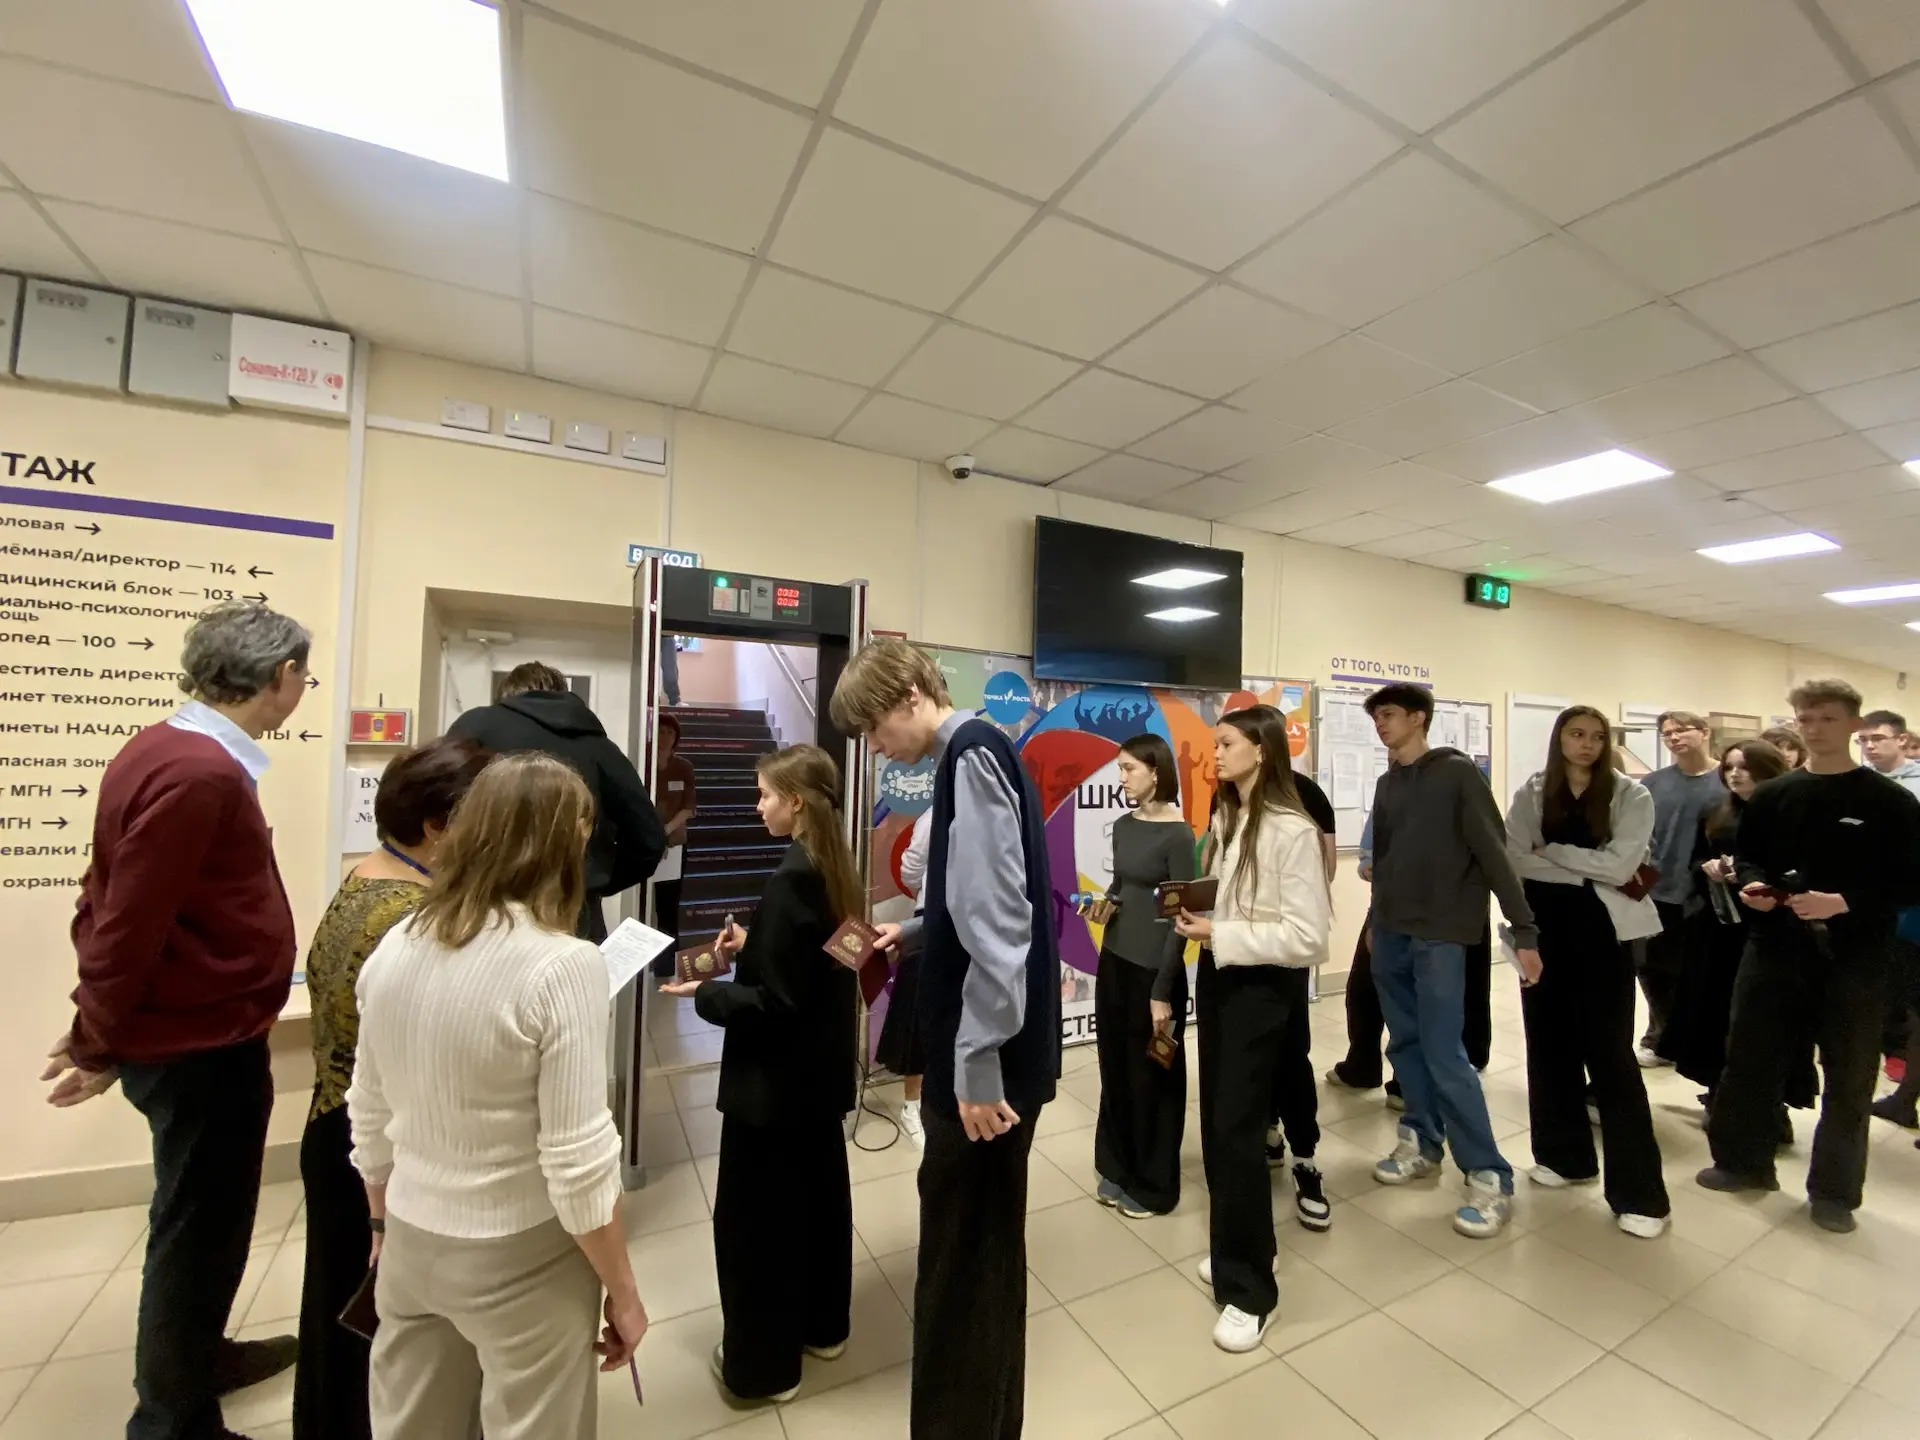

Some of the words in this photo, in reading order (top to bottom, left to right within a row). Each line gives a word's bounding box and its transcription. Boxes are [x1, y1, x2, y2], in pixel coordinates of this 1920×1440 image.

[1, 452, 96, 485] ТАЖ
[210, 562, 237, 576] 114
[123, 581, 173, 597] блок
[203, 588, 234, 601] 103
[82, 635, 116, 648] 100
[1331, 657, 1347, 669] ОТ
[1351, 659, 1386, 676] ТОГО,
[1388, 663, 1411, 676] ЧТО
[1413, 666, 1430, 678] ТЫ
[52, 693, 173, 707] технологии
[11, 785, 52, 796] МГН
[0, 845, 76, 856] евалки
